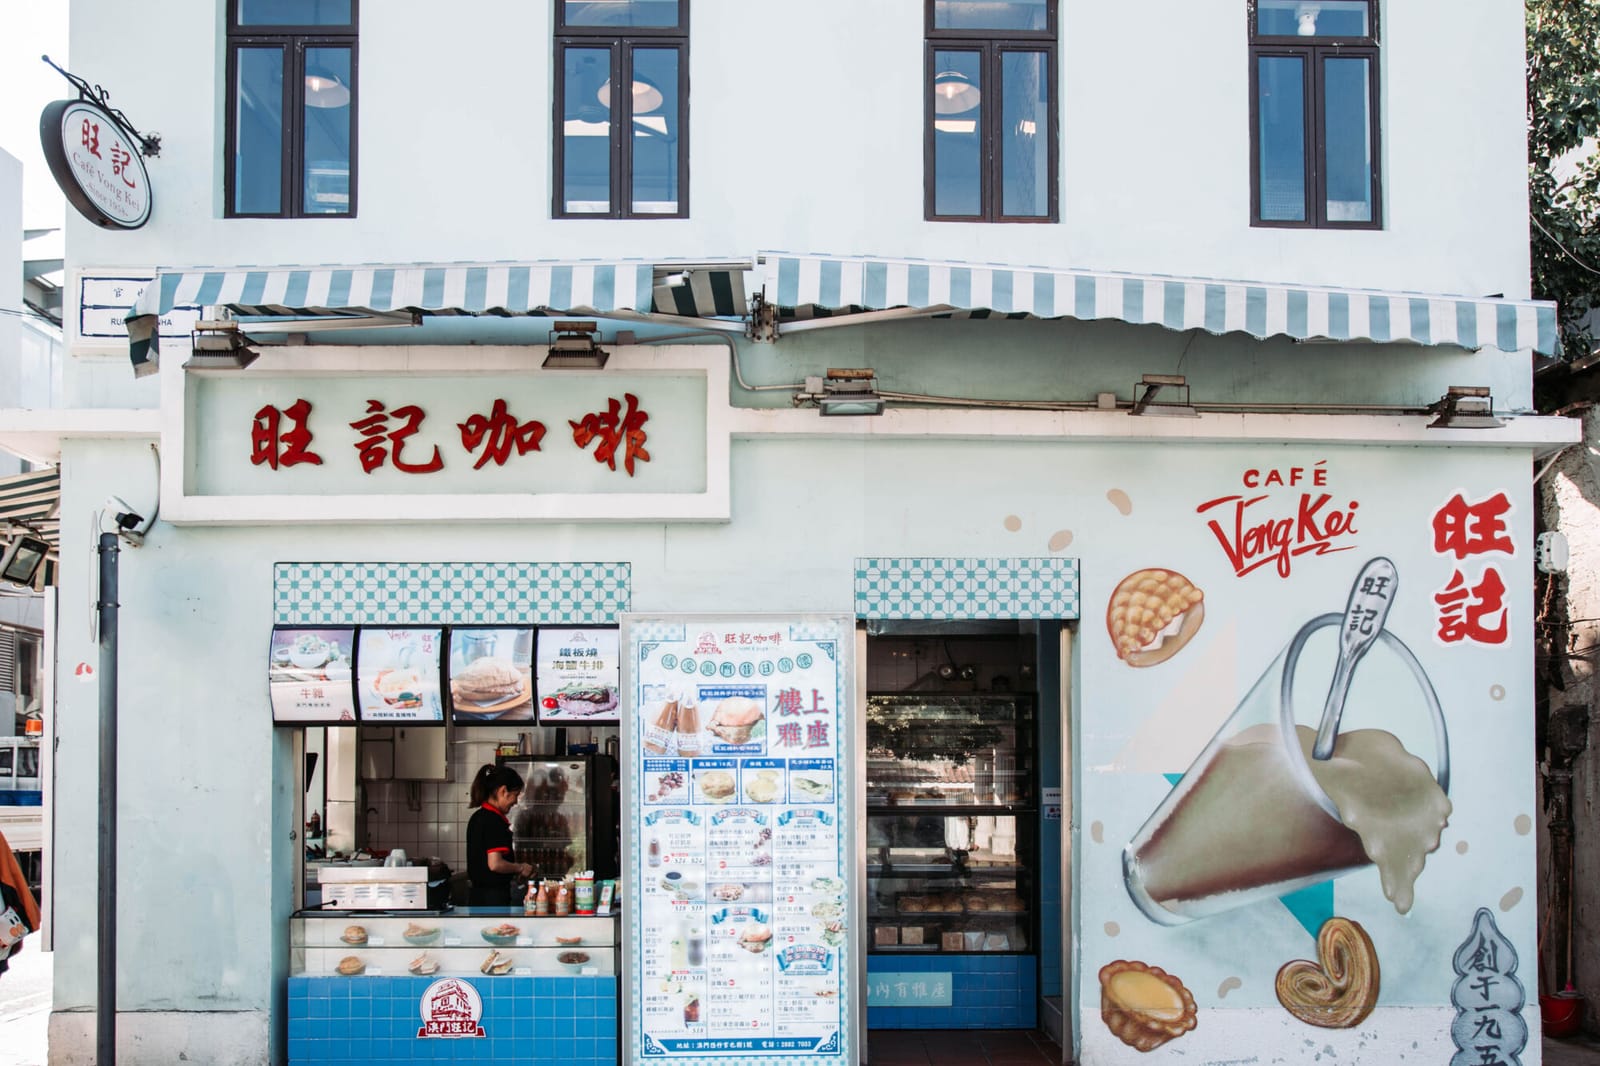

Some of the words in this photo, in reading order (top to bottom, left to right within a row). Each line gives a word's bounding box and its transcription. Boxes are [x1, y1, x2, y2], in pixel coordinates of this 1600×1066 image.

[82, 118, 136, 188] 旺記
[250, 392, 651, 477] 旺記咖啡
[1243, 460, 1328, 488] CAFÉ
[1432, 493, 1515, 645] 旺記
[1350, 575, 1388, 637] 旺記
[724, 632, 783, 646] 旺記咖啡
[772, 687, 830, 717] 樓上
[773, 720, 830, 750] 雅座
[867, 982, 945, 999] 內有雅座
[427, 1021, 475, 1033] 澳門旺記
